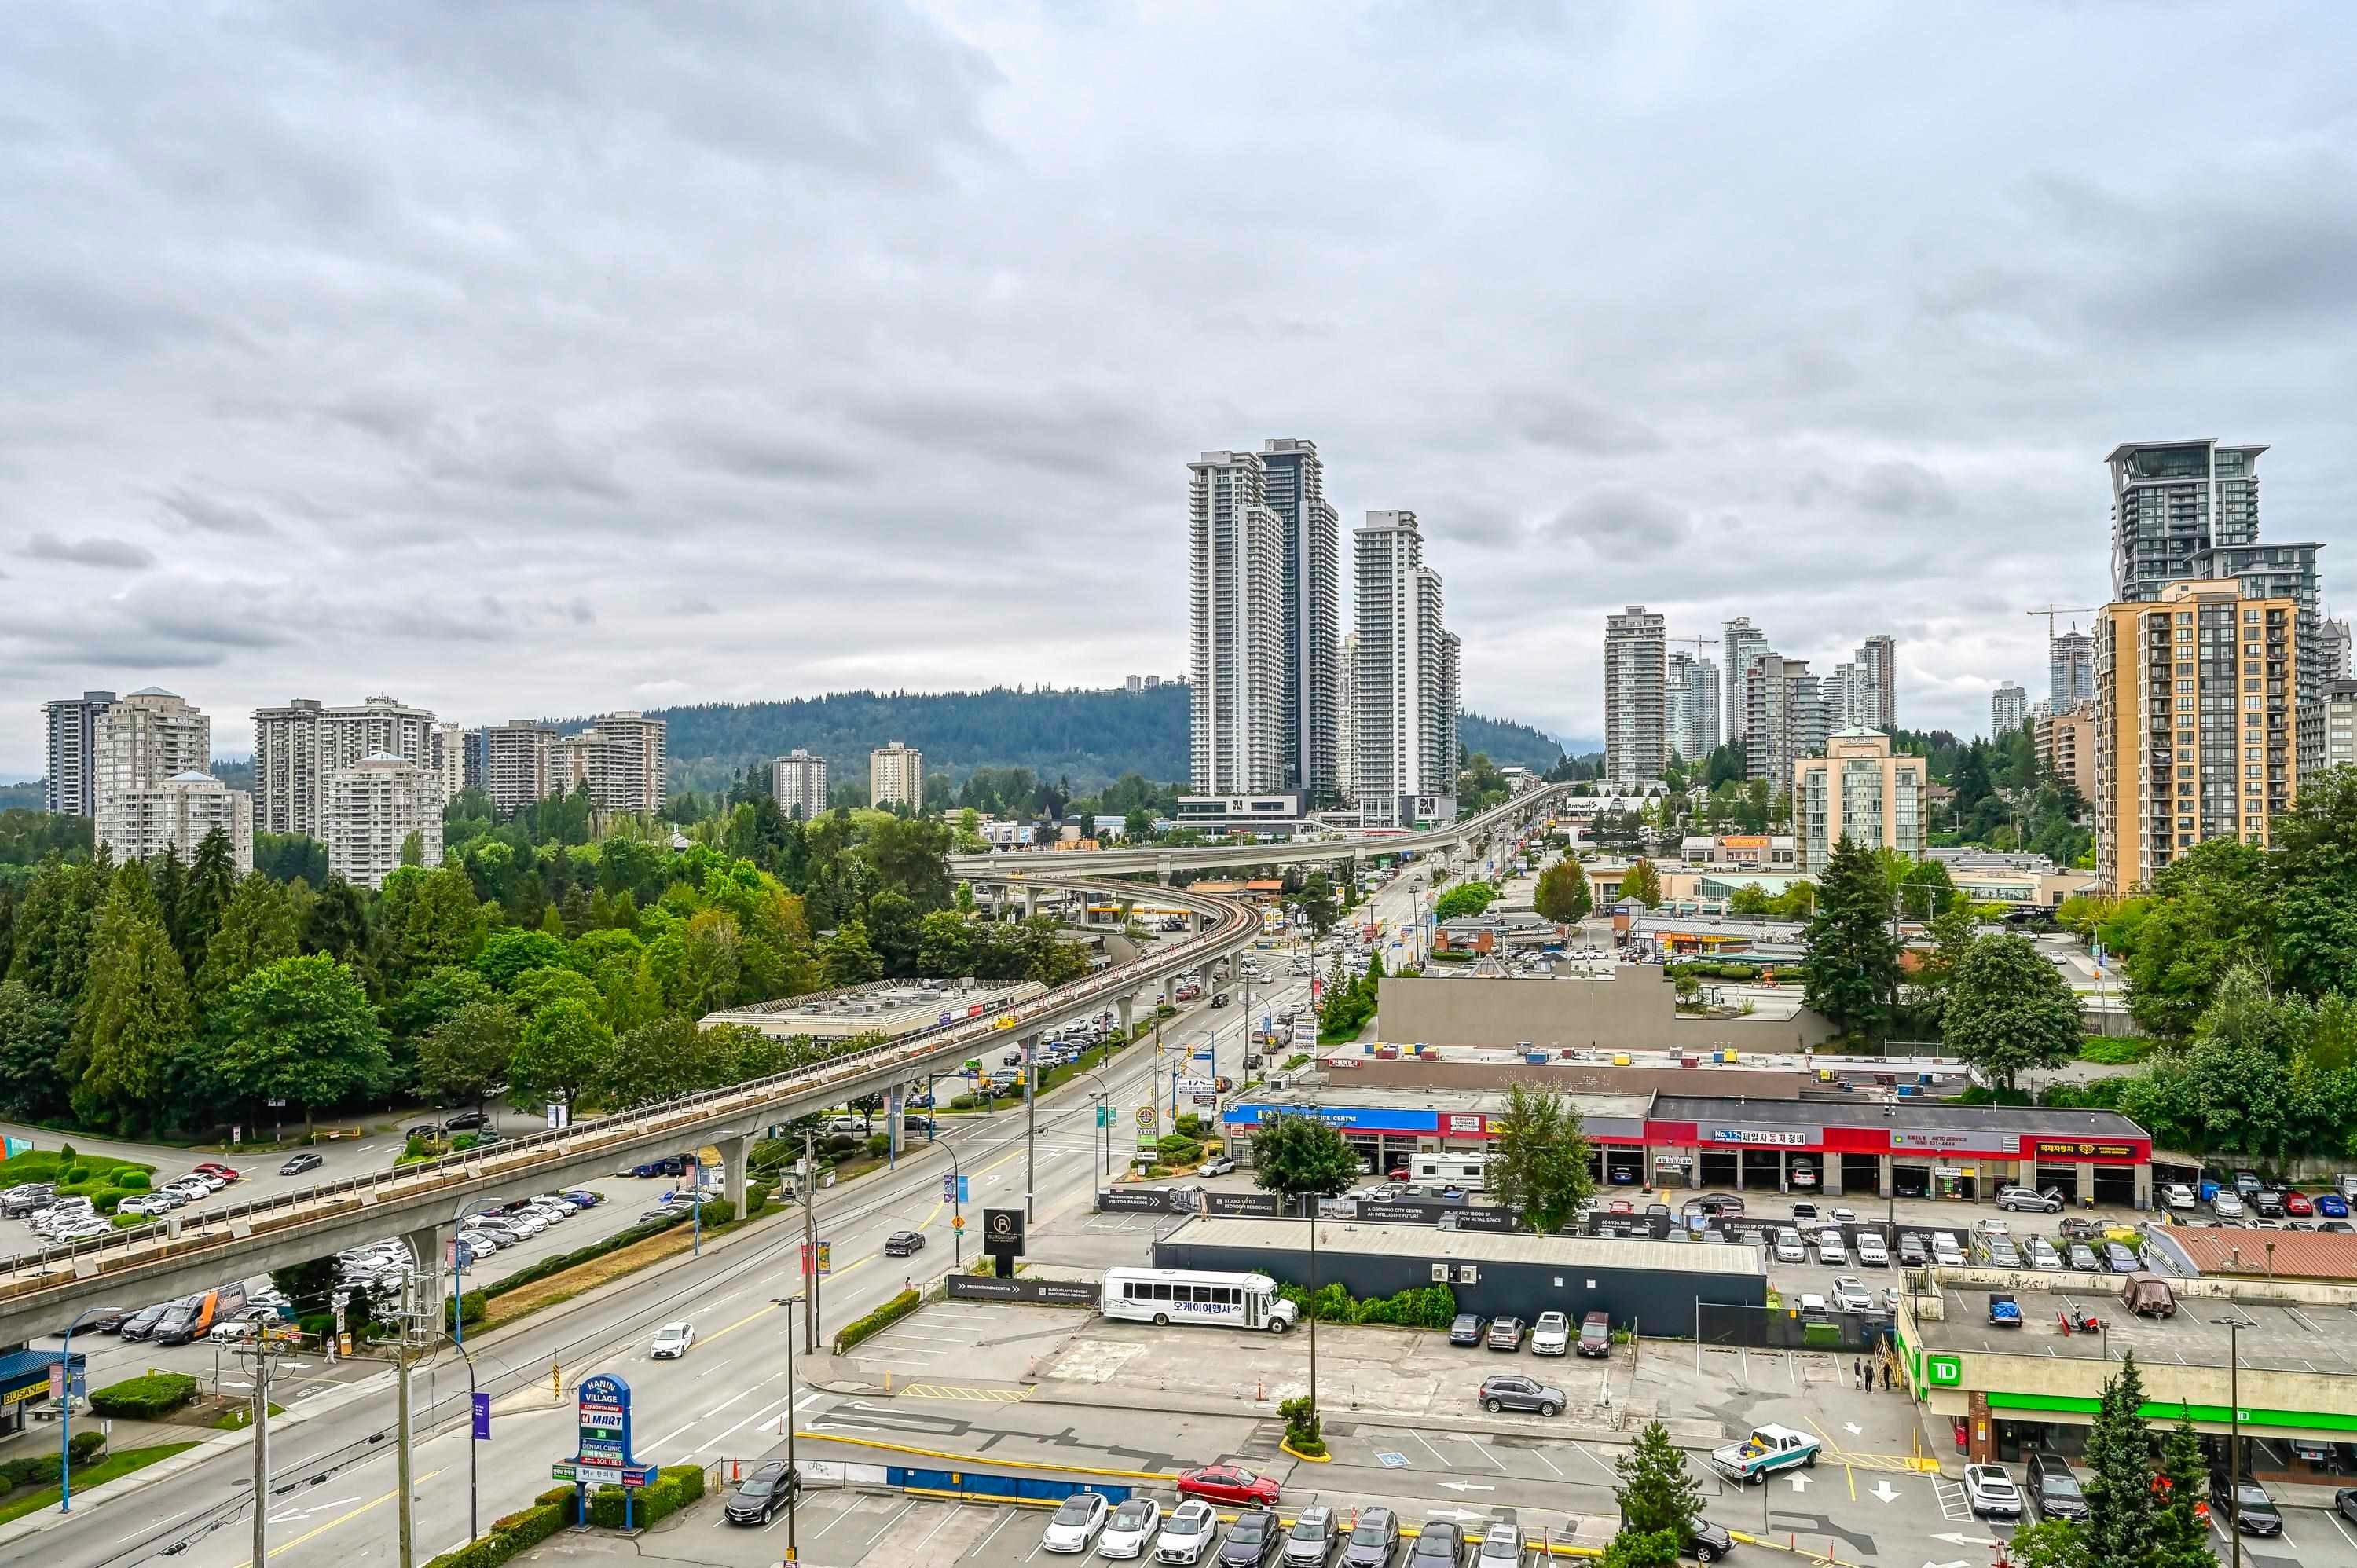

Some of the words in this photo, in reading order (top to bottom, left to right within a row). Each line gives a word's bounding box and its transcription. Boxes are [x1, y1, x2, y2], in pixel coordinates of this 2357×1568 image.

[1173, 1301, 1231, 1314] 오케이여행사
[1932, 1362, 1957, 1379] TD
[587, 1380, 616, 1391] HANIN
[5, 1385, 37, 1403] BUSAN
[585, 1393, 618, 1403] VILLAGE
[592, 1415, 621, 1426] MART
